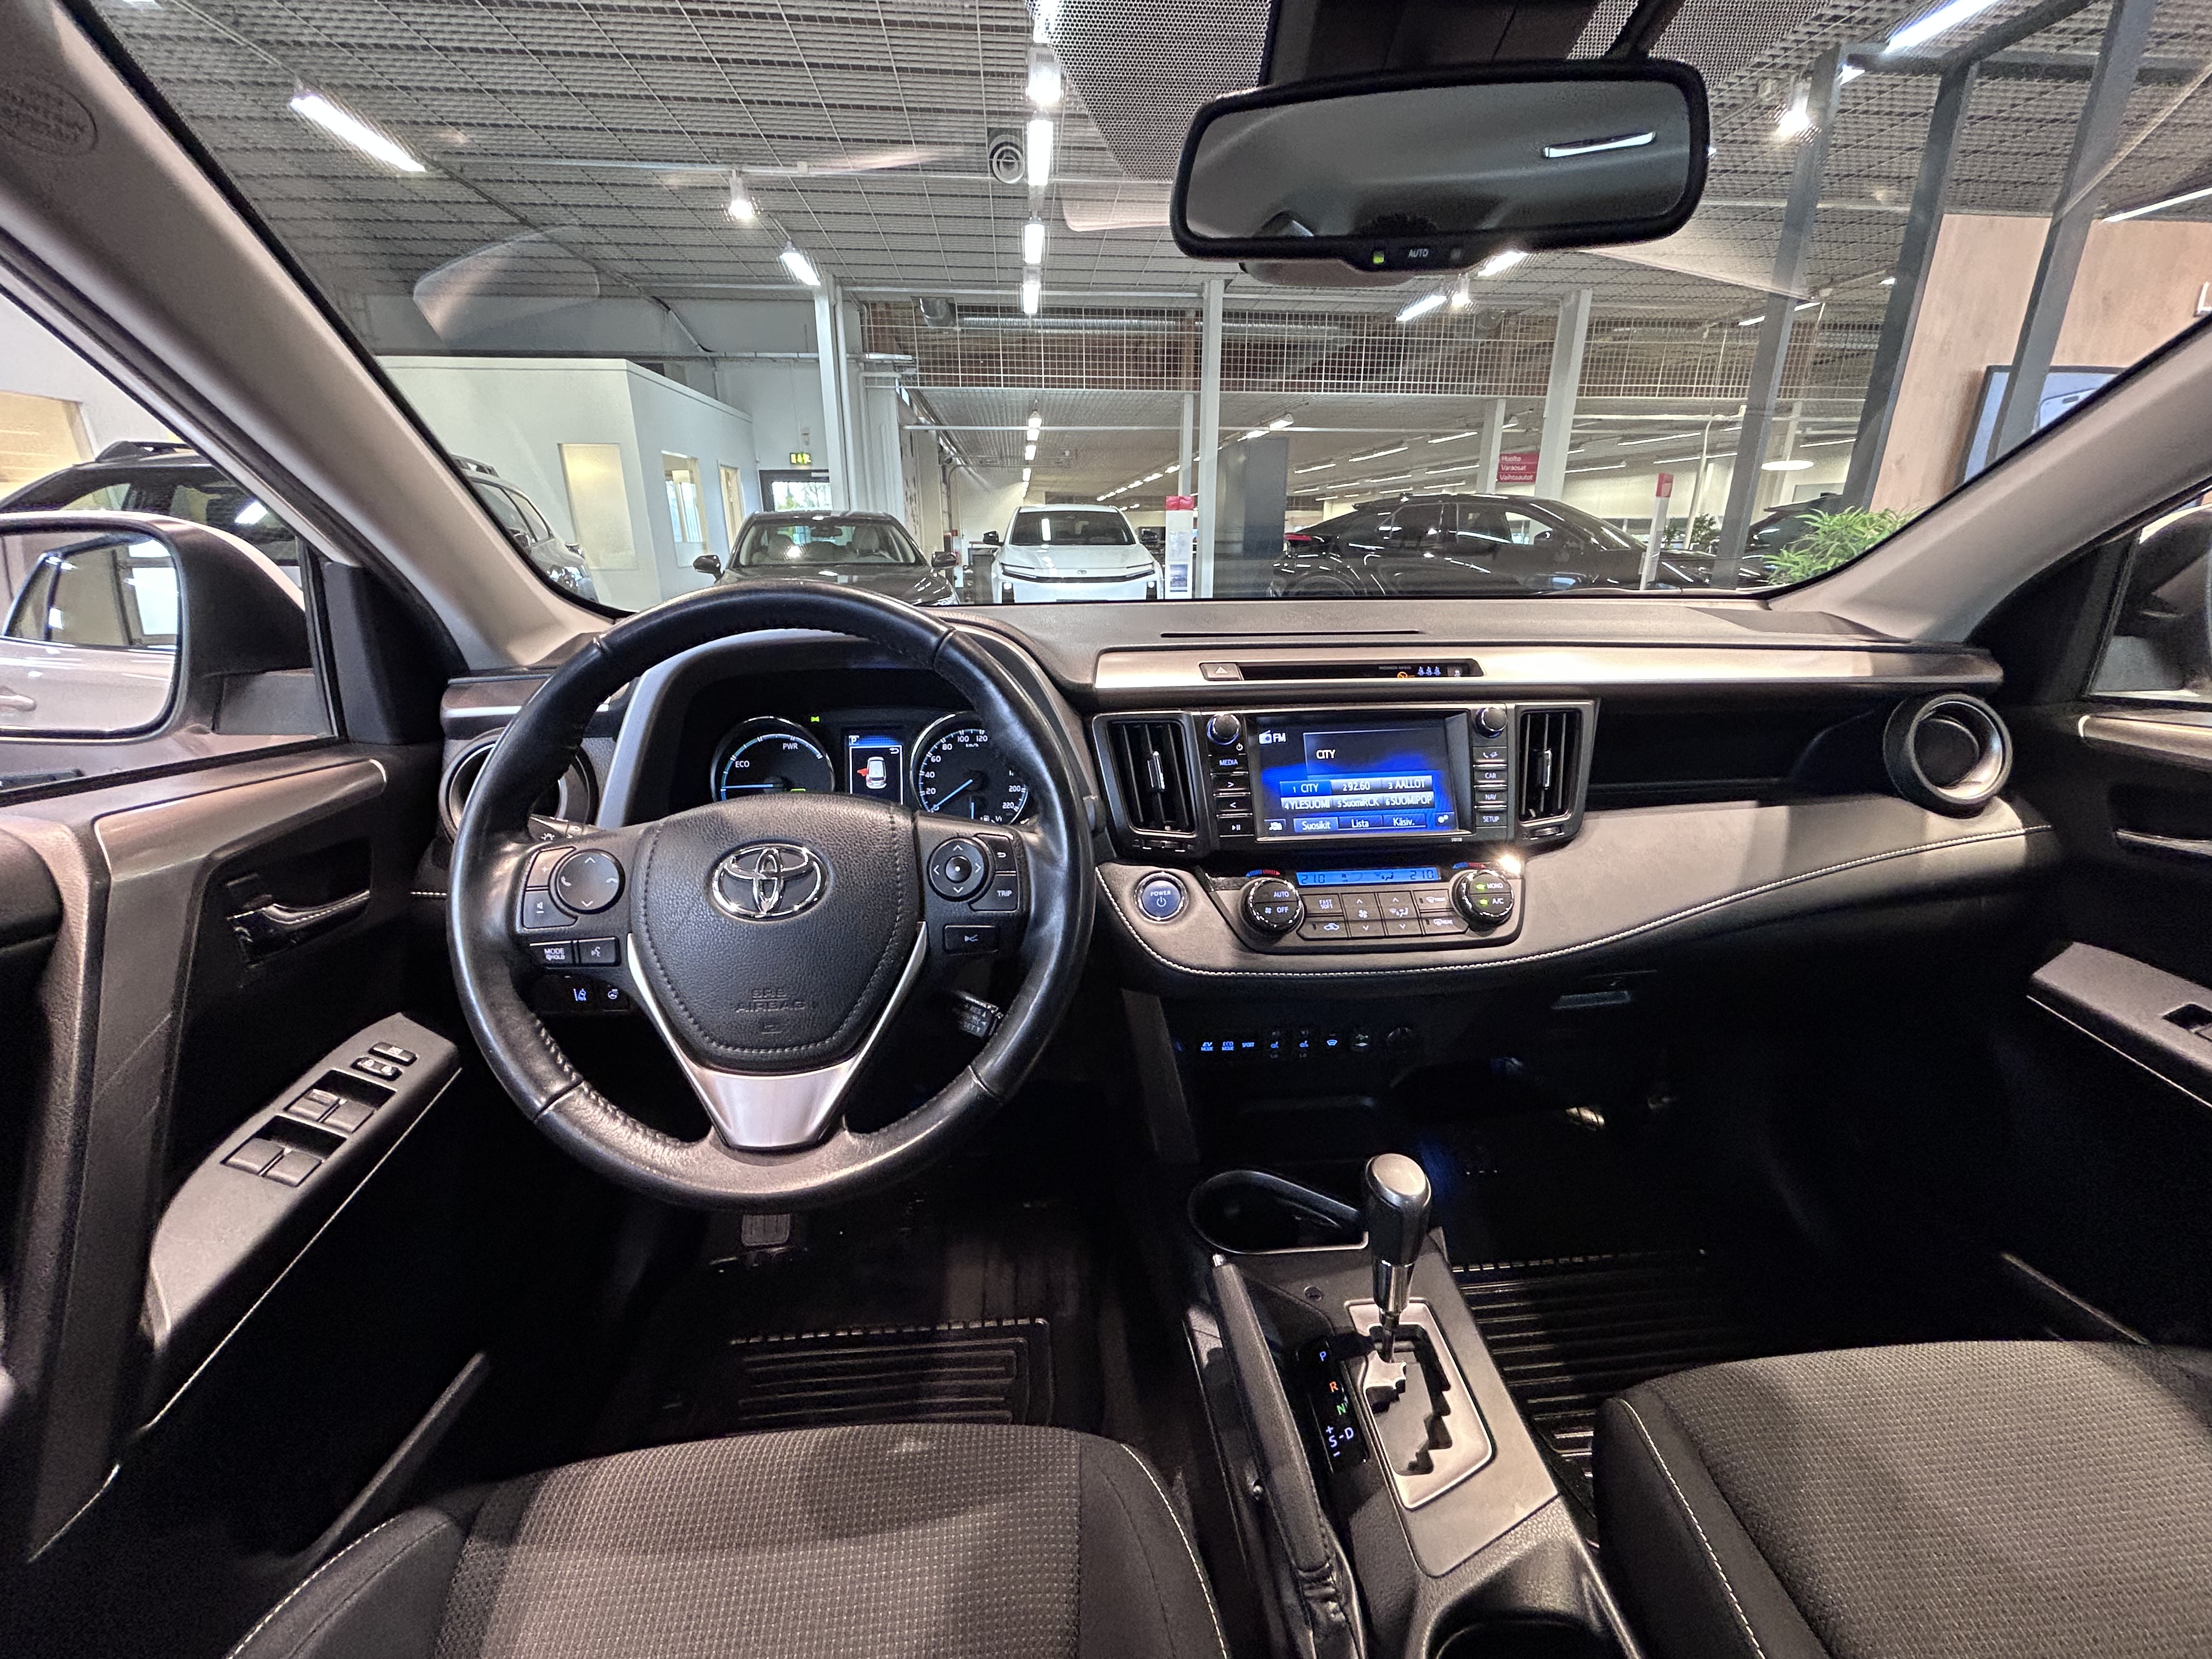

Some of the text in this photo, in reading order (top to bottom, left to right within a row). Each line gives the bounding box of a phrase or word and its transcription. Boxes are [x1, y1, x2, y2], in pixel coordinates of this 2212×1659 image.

[1408, 248, 1429, 257] AUTO
[1272, 732, 1286, 743] FM
[1316, 749, 1336, 759] CITY
[1301, 783, 1319, 793] CITY
[1348, 781, 1371, 791] 92.60
[1395, 778, 1426, 789] AALLOT
[1290, 798, 1330, 810] YLESUOMI
[1302, 820, 1331, 831] Suosikit
[1351, 819, 1369, 828] Lista
[1392, 817, 1415, 827] Käsiv.
[1319, 1351, 1327, 1362] P
[1329, 1381, 1339, 1393] R
[1336, 1403, 1346, 1415] N
